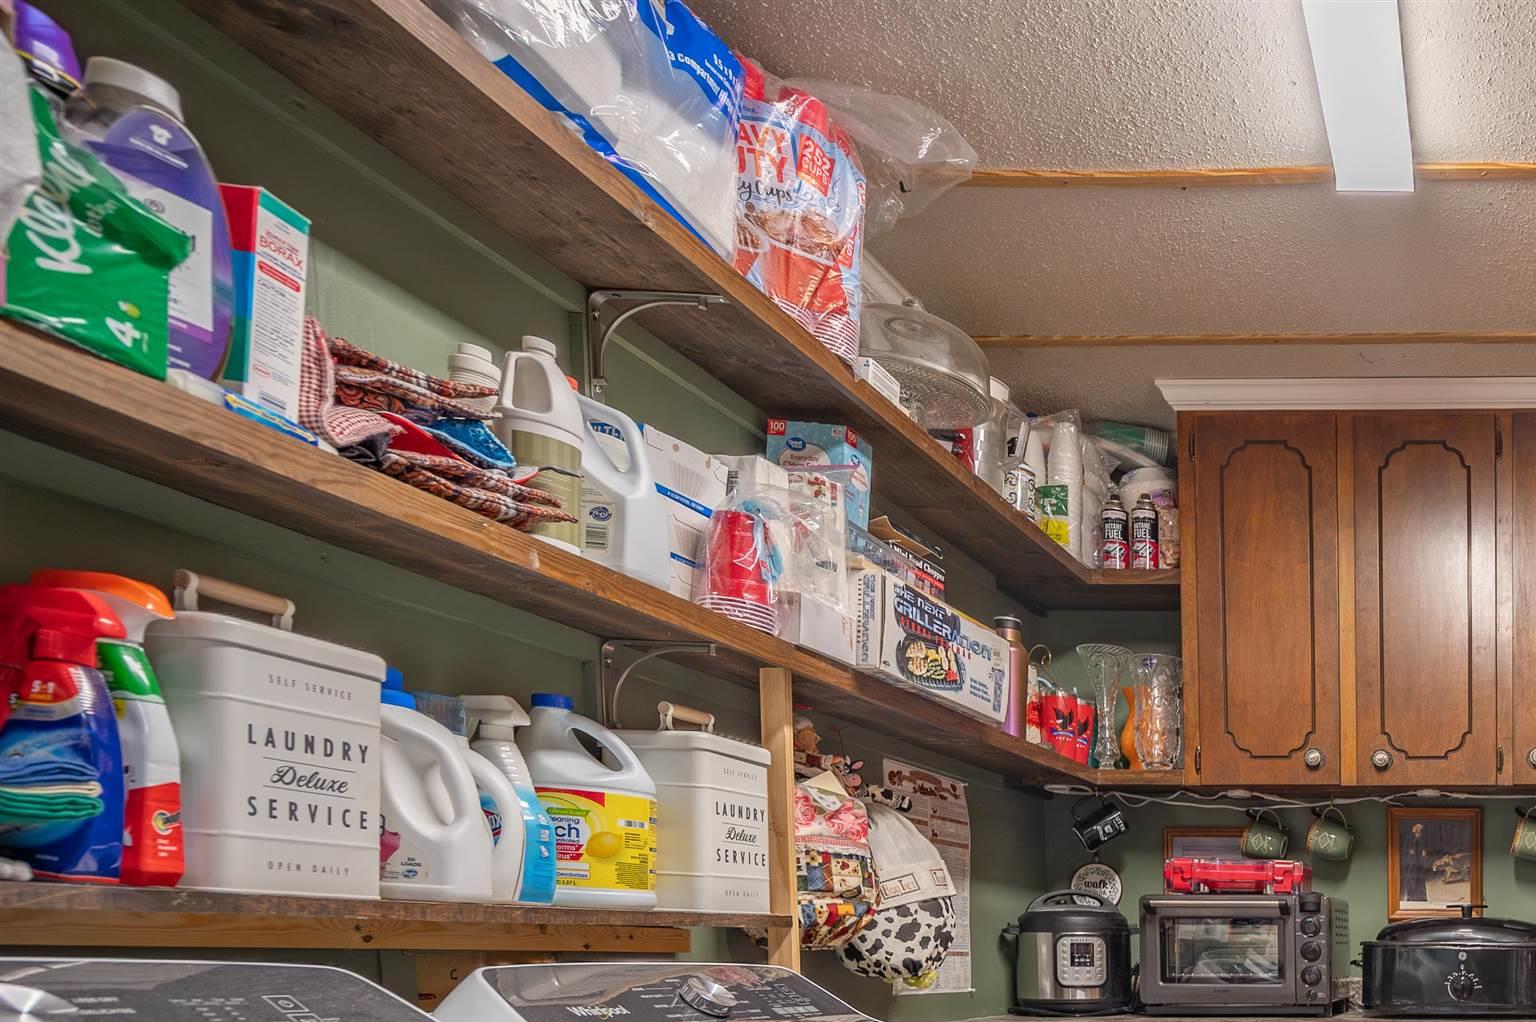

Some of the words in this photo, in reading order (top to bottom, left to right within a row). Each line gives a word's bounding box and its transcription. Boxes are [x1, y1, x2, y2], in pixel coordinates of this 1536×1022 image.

[803, 138, 831, 177] 252
[802, 155, 828, 185] CUPS
[259, 235, 304, 272] BORAX
[769, 421, 785, 432] 100
[790, 453, 820, 464] Everyday
[1105, 529, 1123, 540] FUEL
[1133, 529, 1151, 540] FUEL
[268, 673, 297, 688] SELF
[304, 682, 353, 702] SERVICE
[247, 723, 369, 764] LAUNDRY
[270, 764, 349, 794] Deluxe
[247, 796, 368, 830] SERVICE
[715, 800, 765, 823] LAUNDRY
[725, 826, 758, 844] Deluxe
[267, 860, 301, 872] OPEN
[312, 863, 350, 876] DAILY
[716, 849, 766, 867] SERVICE
[566, 1004, 631, 1020] Whirlpool
